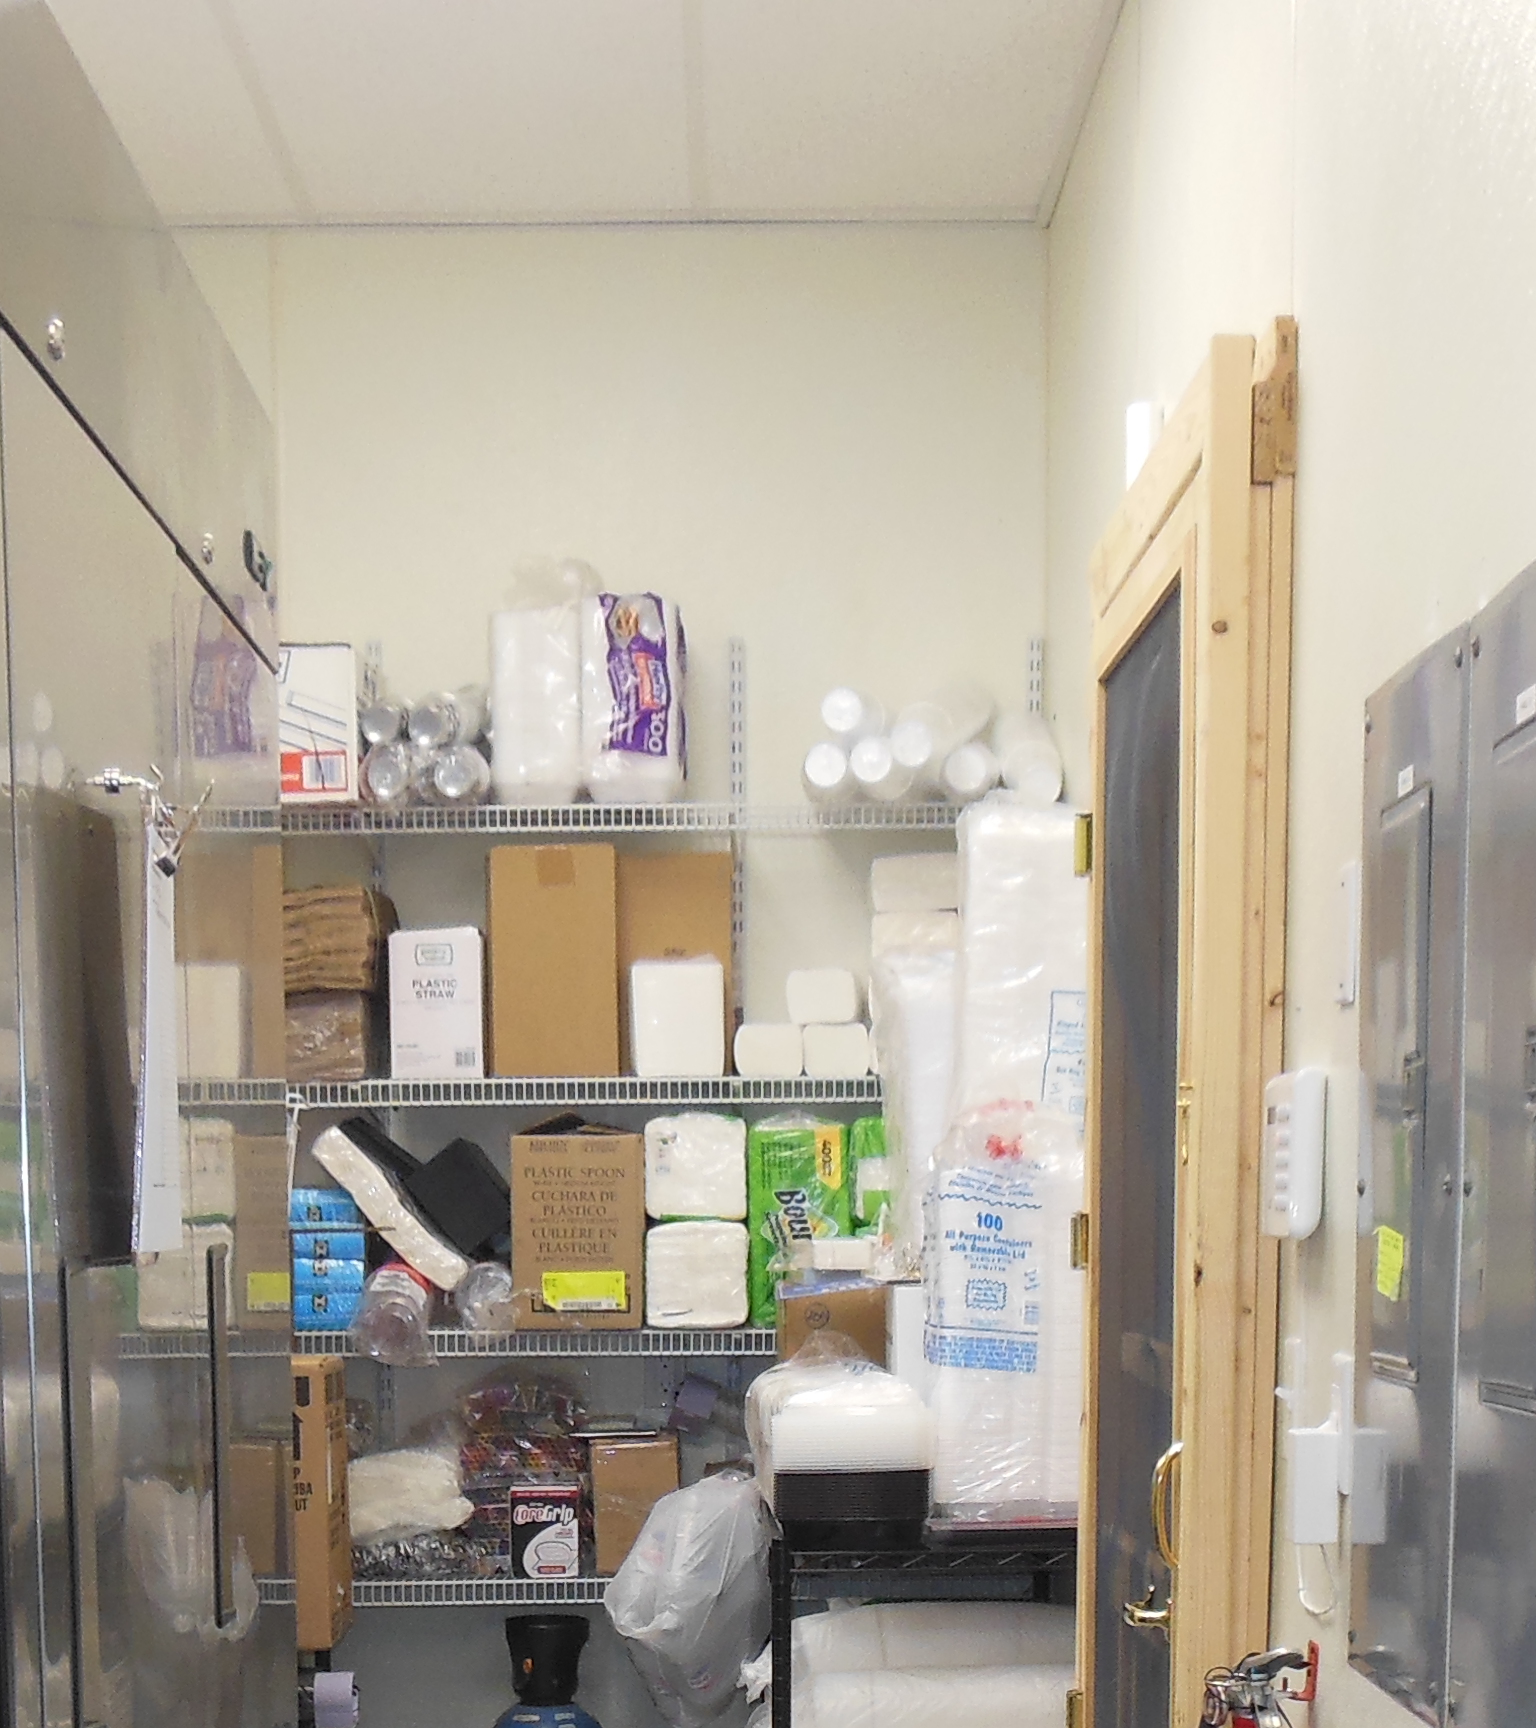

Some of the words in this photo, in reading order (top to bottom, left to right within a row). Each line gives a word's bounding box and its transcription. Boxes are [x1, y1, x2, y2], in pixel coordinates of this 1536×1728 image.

[412, 979, 457, 989] PLASTIC
[415, 990, 455, 999] STRAW
[524, 1167, 573, 1178] PLASTIC
[580, 1167, 625, 1178] SPOON
[531, 1191, 595, 1202] CUCHARA
[600, 1191, 617, 1202] DE
[976, 1211, 1004, 1232] 100
[539, 1242, 608, 1255] PLASTIQUE
[513, 1504, 575, 1526] CoreGrip
